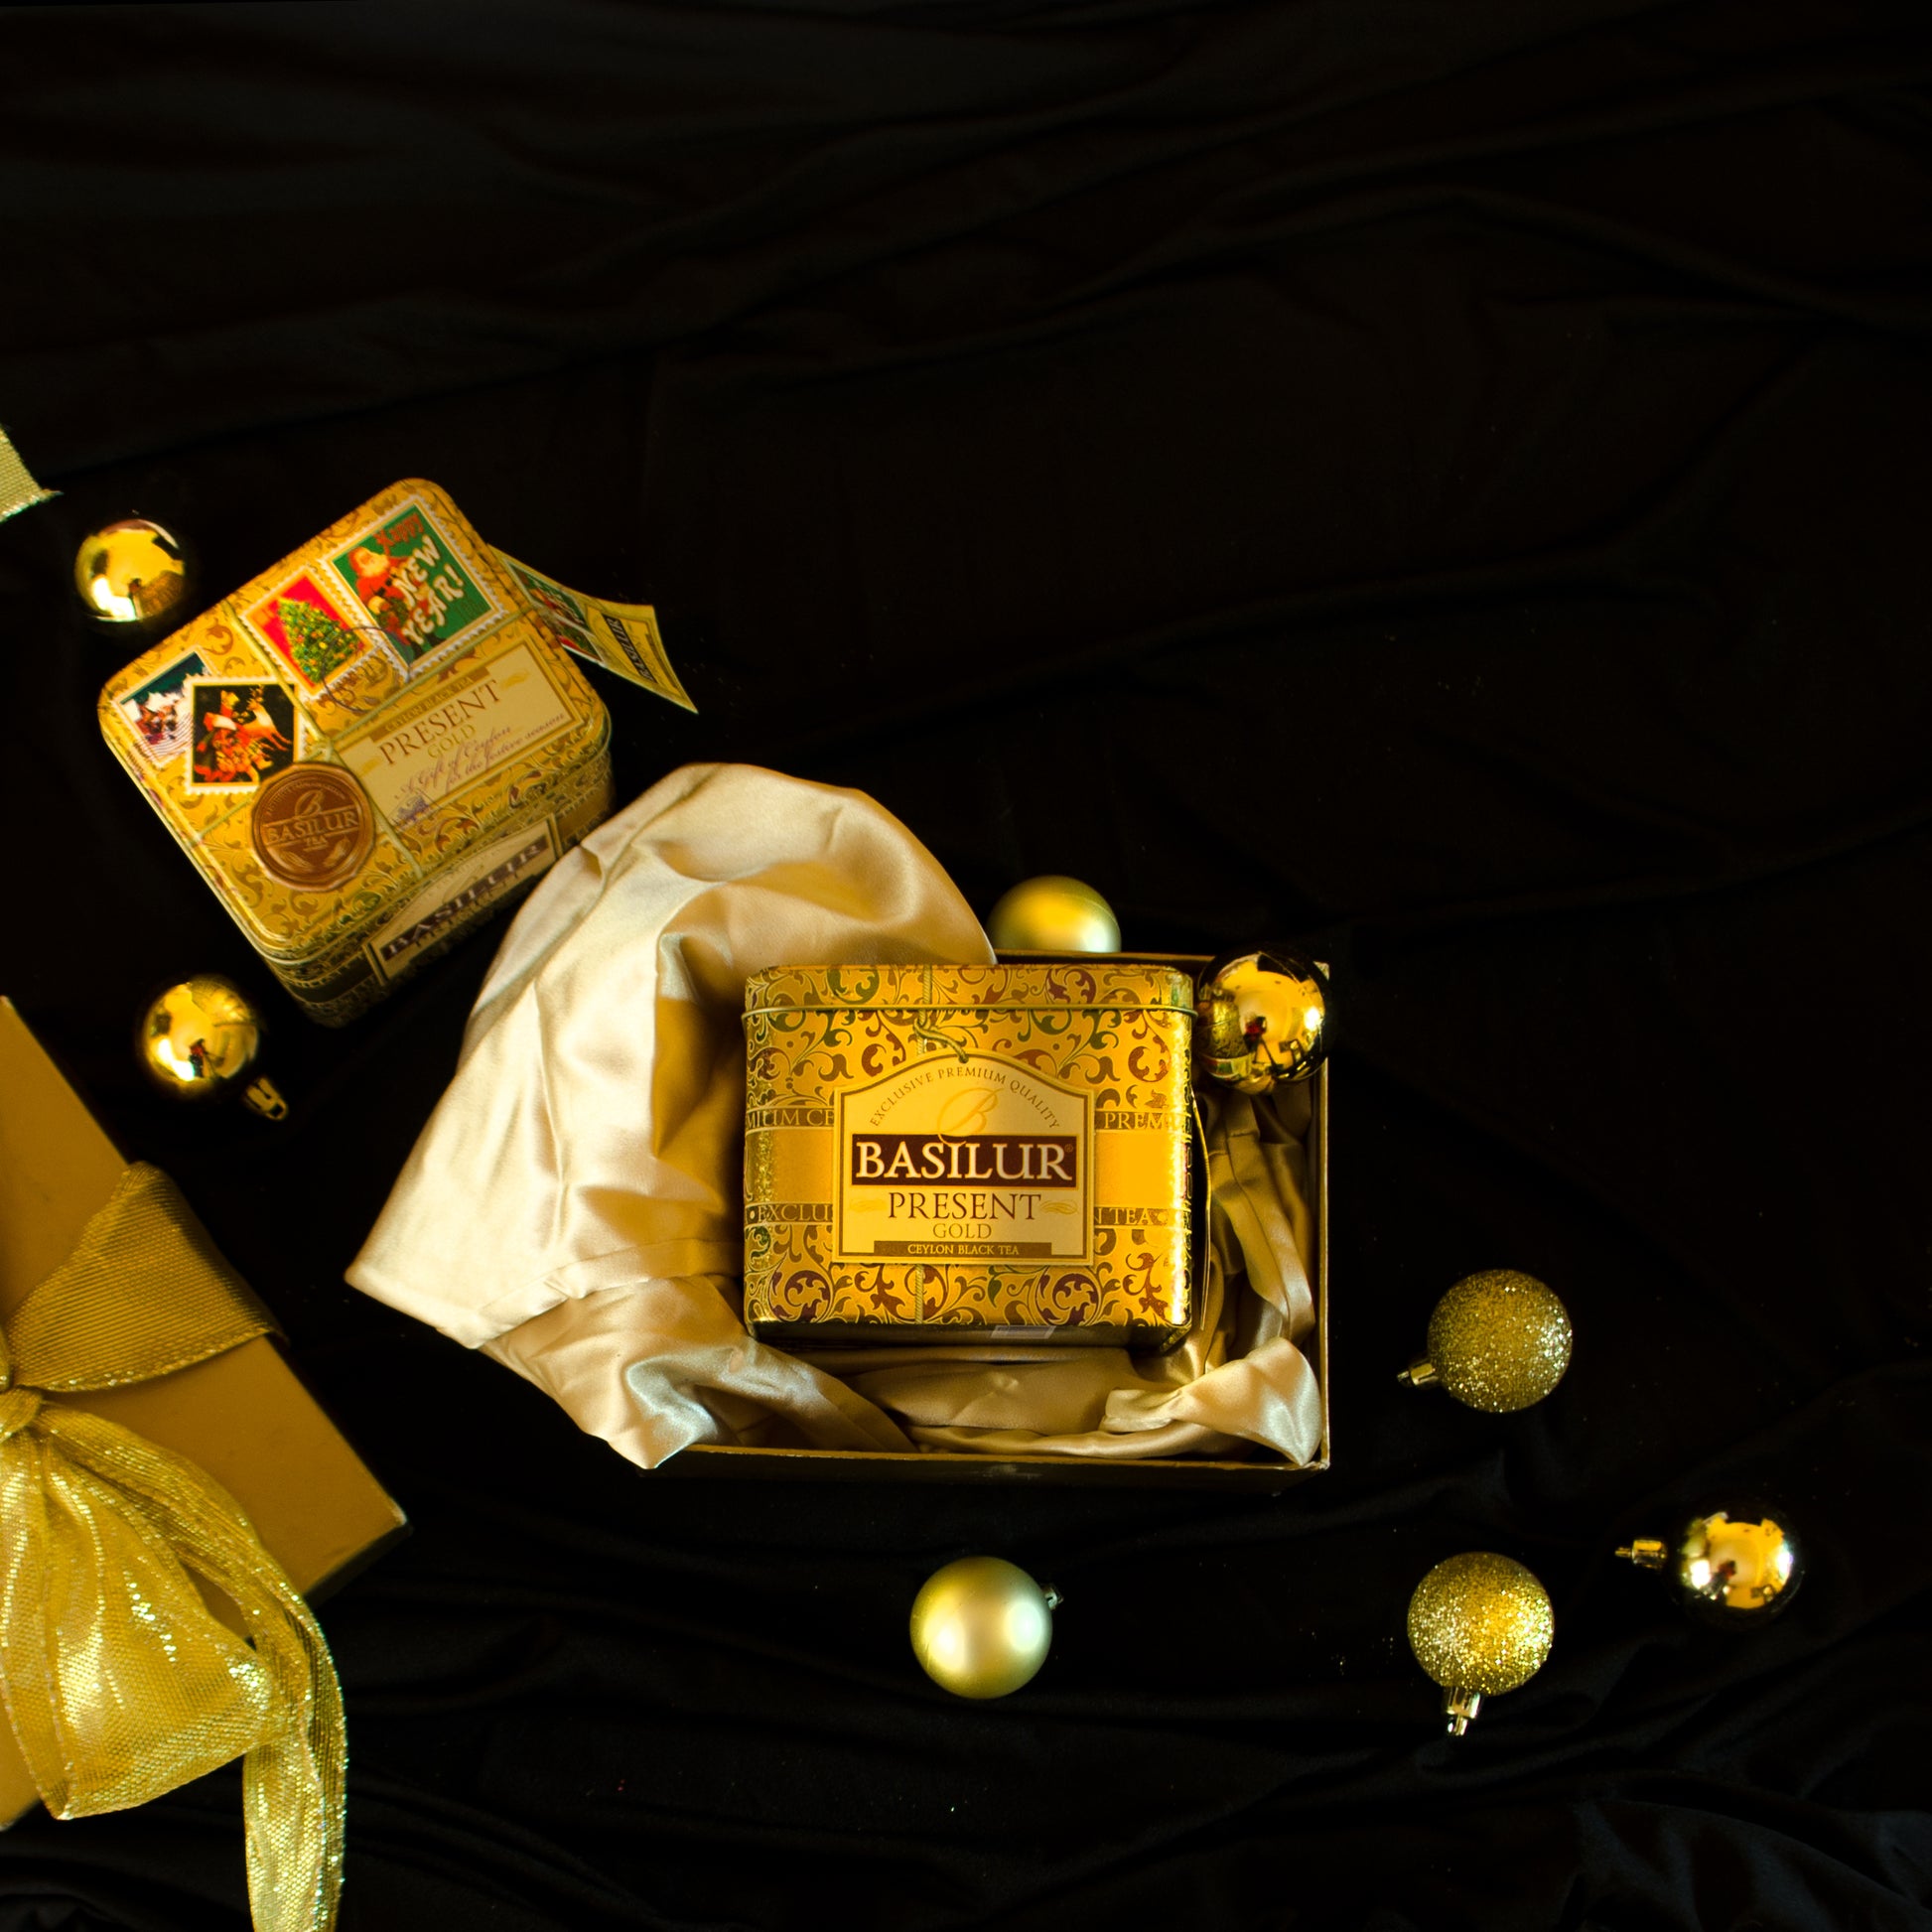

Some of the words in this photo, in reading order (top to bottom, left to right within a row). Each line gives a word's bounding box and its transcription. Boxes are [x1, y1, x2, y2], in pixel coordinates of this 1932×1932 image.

[390, 535, 440, 610] NEW
[401, 563, 465, 645] YEAR!
[378, 679, 500, 765] PRESENT
[427, 723, 476, 759] GOLD
[265, 810, 359, 843] BASILUR
[870, 1071, 933, 1128] EXCLUSIVE
[938, 1066, 1007, 1084] PREMIUM
[1010, 1078, 1059, 1129] QUALITY
[758, 1203, 834, 1223] EXCLU
[889, 1192, 1041, 1220] PRESENT
[1109, 1207, 1154, 1225] TEA
[932, 1223, 992, 1239] GOLD
[907, 1244, 954, 1255] CEYLON
[958, 1244, 994, 1255] BLACK
[997, 1244, 1020, 1256] TEA
